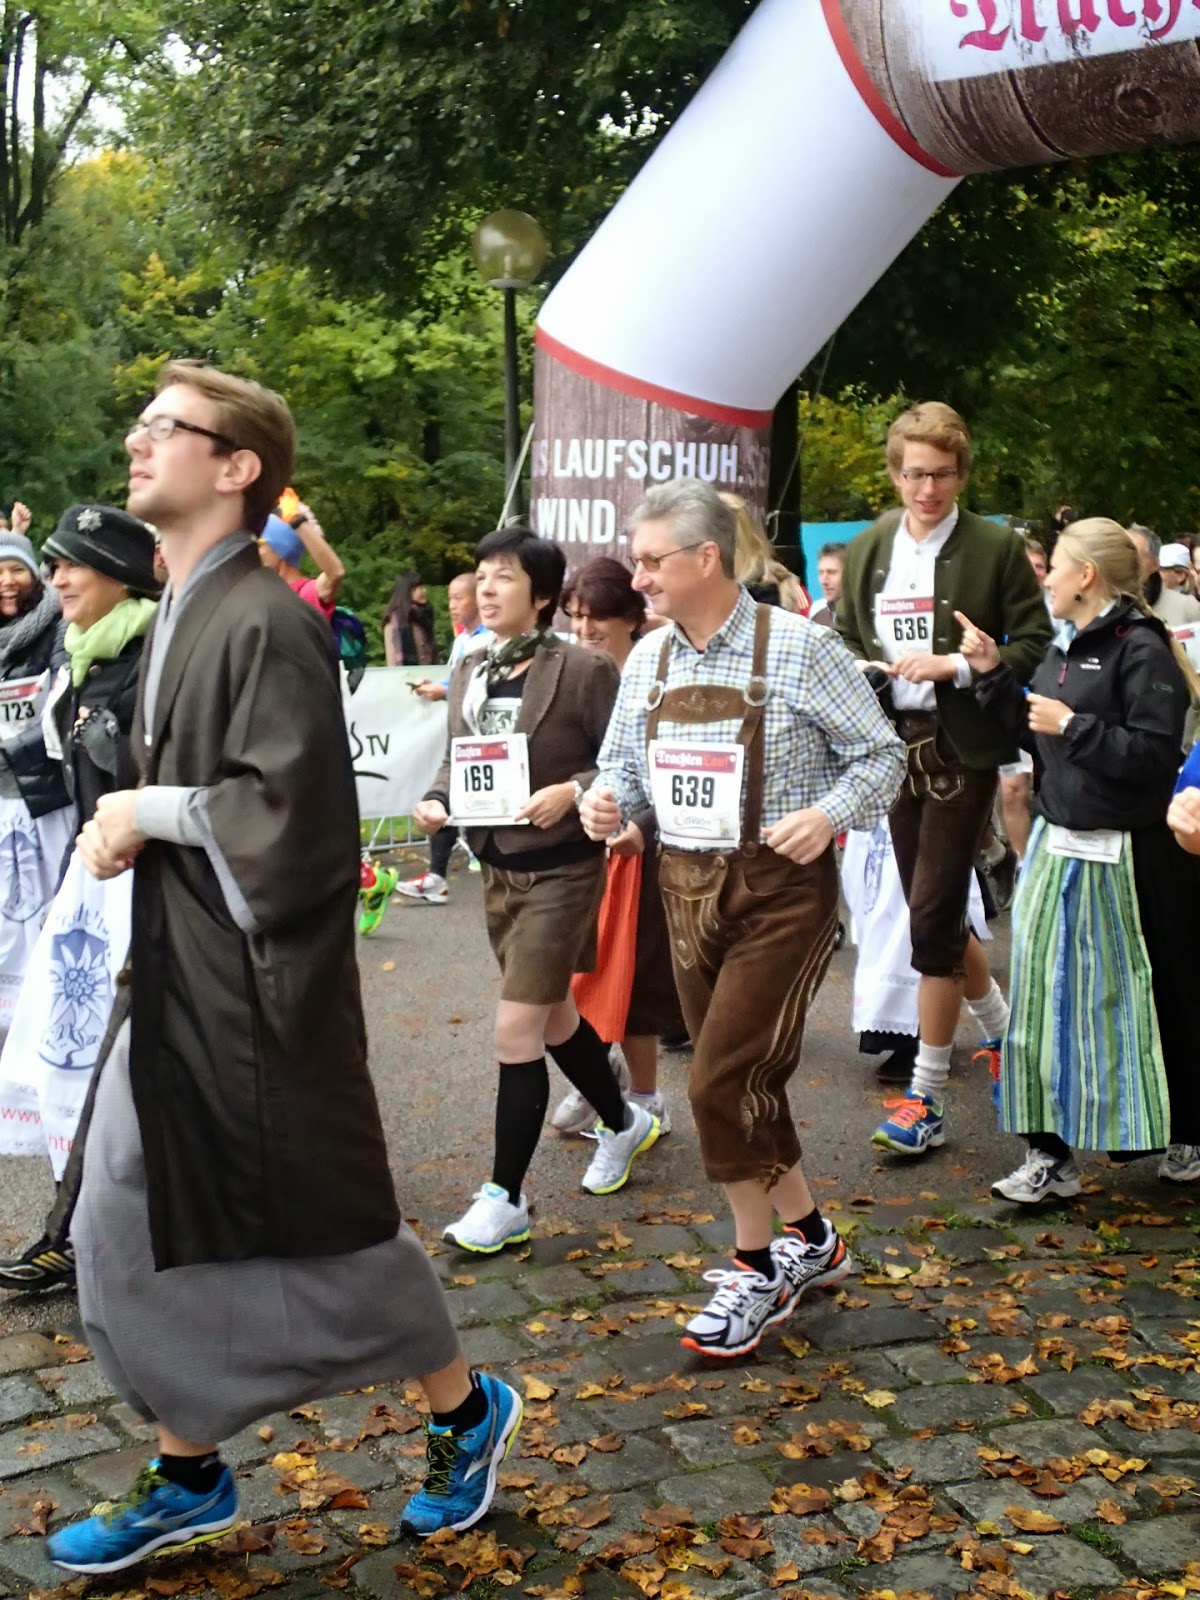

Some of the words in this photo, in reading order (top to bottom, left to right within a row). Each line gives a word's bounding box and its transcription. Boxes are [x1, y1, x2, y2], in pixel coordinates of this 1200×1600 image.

[553, 438, 743, 483] LAUFSCHUH.
[537, 498, 628, 544] WIND.
[893, 616, 928, 641] 636
[1, 701, 35, 721] 723
[464, 765, 494, 792] 169
[671, 774, 715, 808] 639
